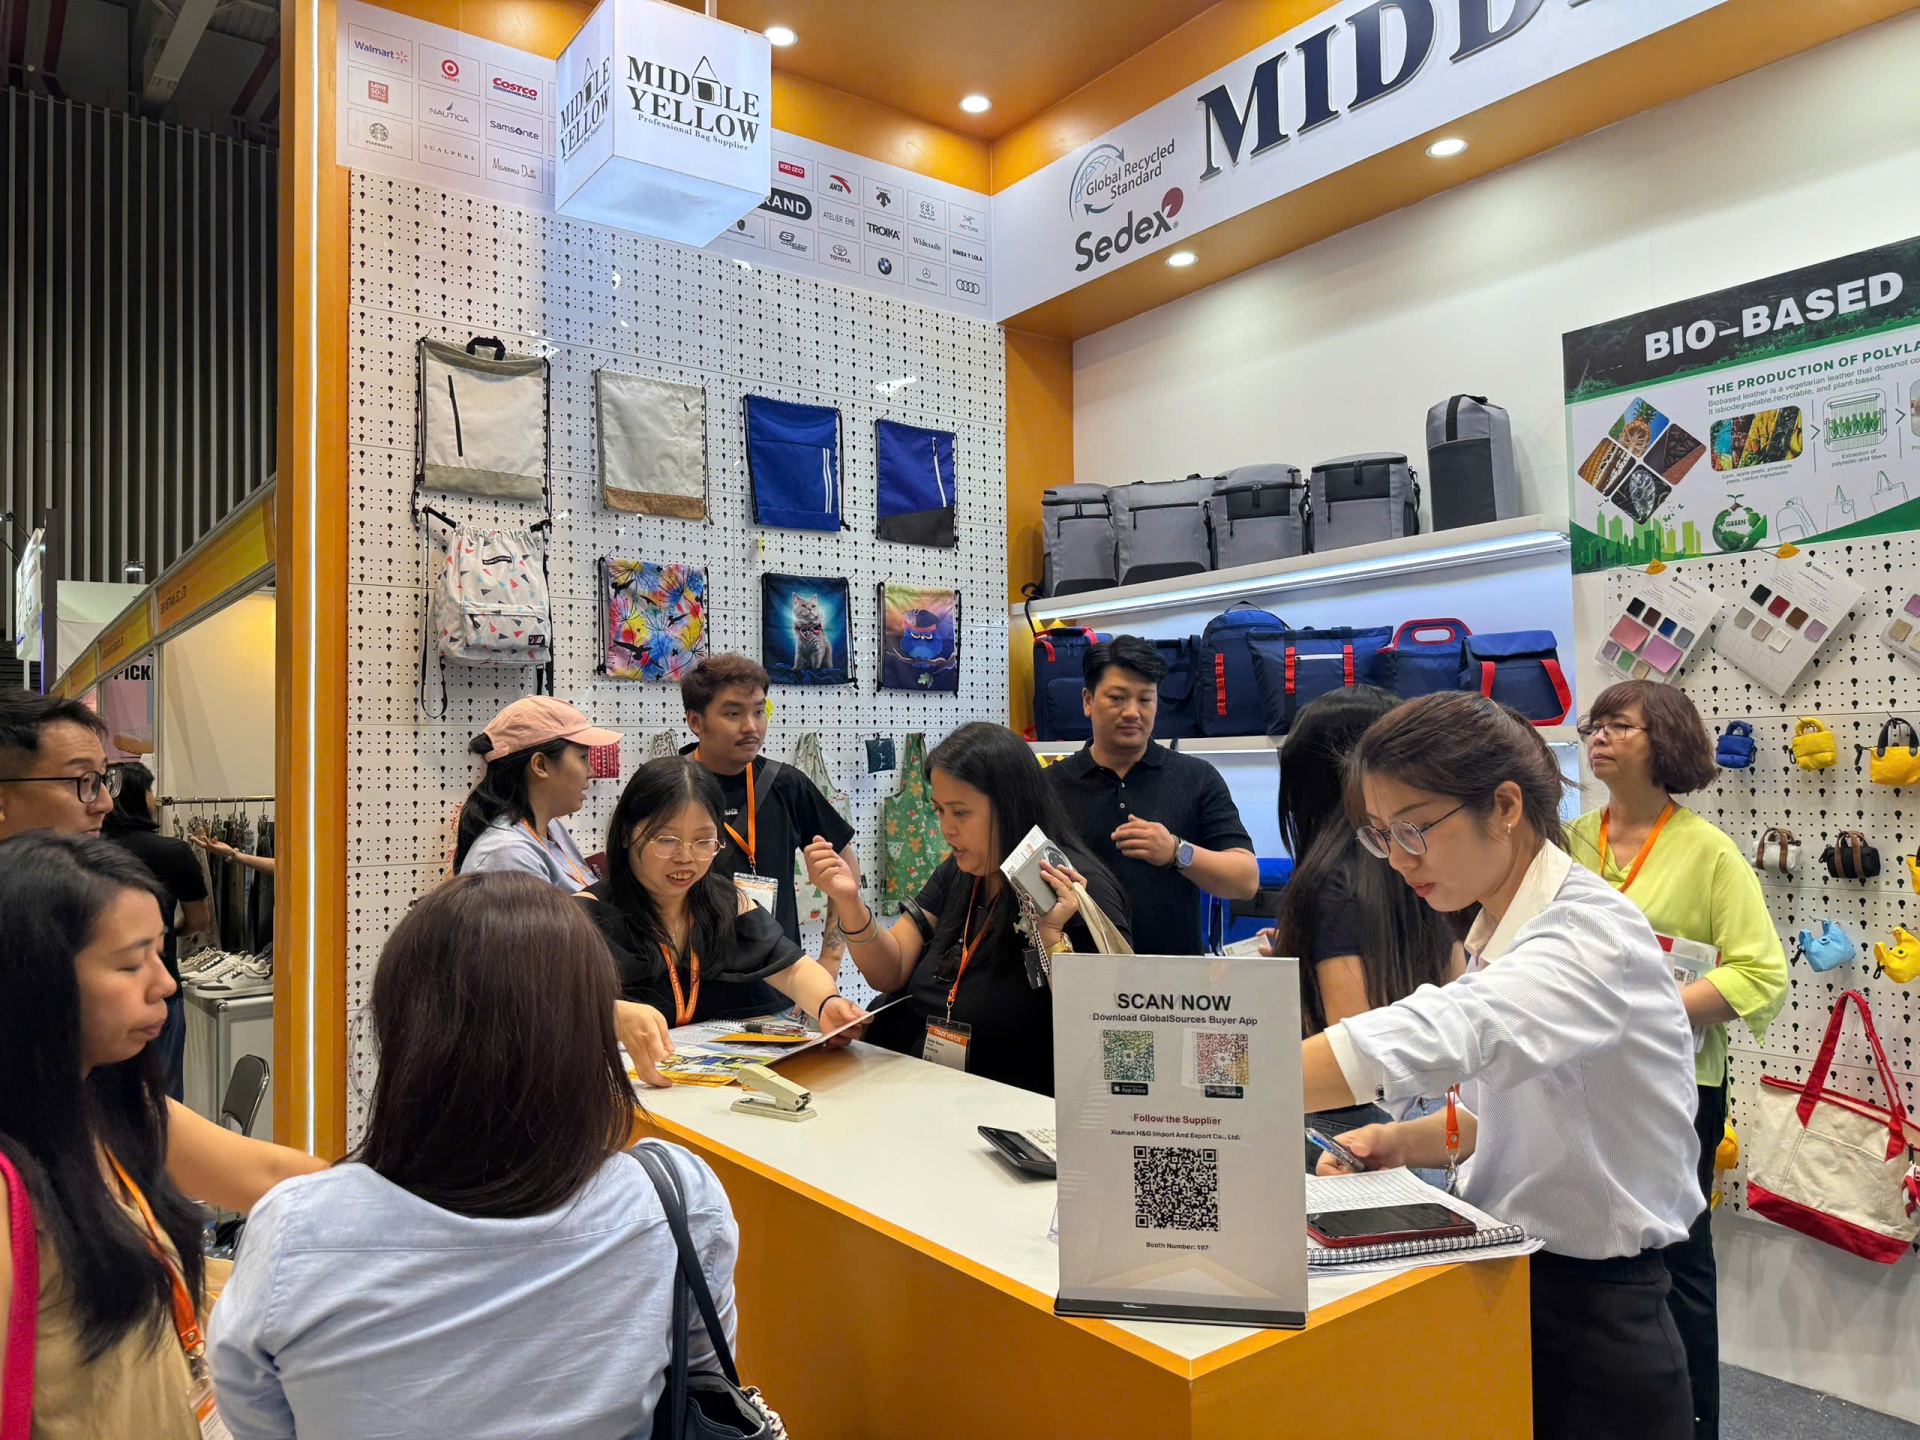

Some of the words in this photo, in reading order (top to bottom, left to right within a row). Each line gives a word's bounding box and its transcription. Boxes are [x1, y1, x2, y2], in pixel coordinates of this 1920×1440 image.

[354, 40, 394, 59] Walmart
[493, 77, 538, 97] COSTCO
[1197, 0, 1592, 181] MIDD
[429, 107, 469, 123] NAUTICA
[560, 85, 610, 160] YELLOW
[626, 85, 760, 144] YELLOW
[489, 120, 539, 140] Samsonite
[638, 113, 692, 136] Professional
[695, 128, 710, 142] Bag
[712, 135, 749, 151] Supplier
[423, 144, 475, 161] SCALPERS
[1086, 167, 1121, 196] Global
[1124, 138, 1175, 177] Recycled
[829, 183, 843, 192] ANTA
[1110, 161, 1162, 200] Standard
[823, 211, 843, 223] ATELIER
[866, 222, 899, 240] TROIKA
[1075, 202, 1178, 272] Sedex
[913, 236, 941, 251] Whitcoulls
[829, 254, 852, 264] TOYOTA
[971, 253, 983, 262] LOLA
[1644, 272, 1904, 362] BIO-BASED
[1707, 381, 1734, 396] THE
[1738, 360, 1834, 390] PRODUCTION
[1838, 354, 1858, 367] OF
[1862, 341, 1920, 363] POLYLA
[1708, 395, 1741, 407] Biobased
[1743, 389, 1768, 400] leather
[1785, 377, 1825, 391] vegetarian
[1827, 371, 1855, 382] leather
[1857, 366, 1872, 375] that
[1874, 359, 1908, 372] doesnot
[1816, 383, 1831, 393] and
[1833, 374, 1883, 391] plant-based.
[1842, 450, 1869, 459] Extraction
[1725, 518, 1747, 528] GREEN
[114, 665, 153, 681] ICK
[1117, 993, 1174, 1010] SCAN
[1181, 994, 1231, 1011] NOW
[1093, 1013, 1138, 1022] Download
[1140, 1013, 1207, 1024] GlobalSources
[1209, 1016, 1236, 1026] Buyer
[1239, 1016, 1258, 1027] App
[1133, 1113, 1164, 1123] Follow
[1166, 1115, 1181, 1123] the
[1182, 1115, 1222, 1126] Supplier
[1146, 1241, 1165, 1249] Booth
